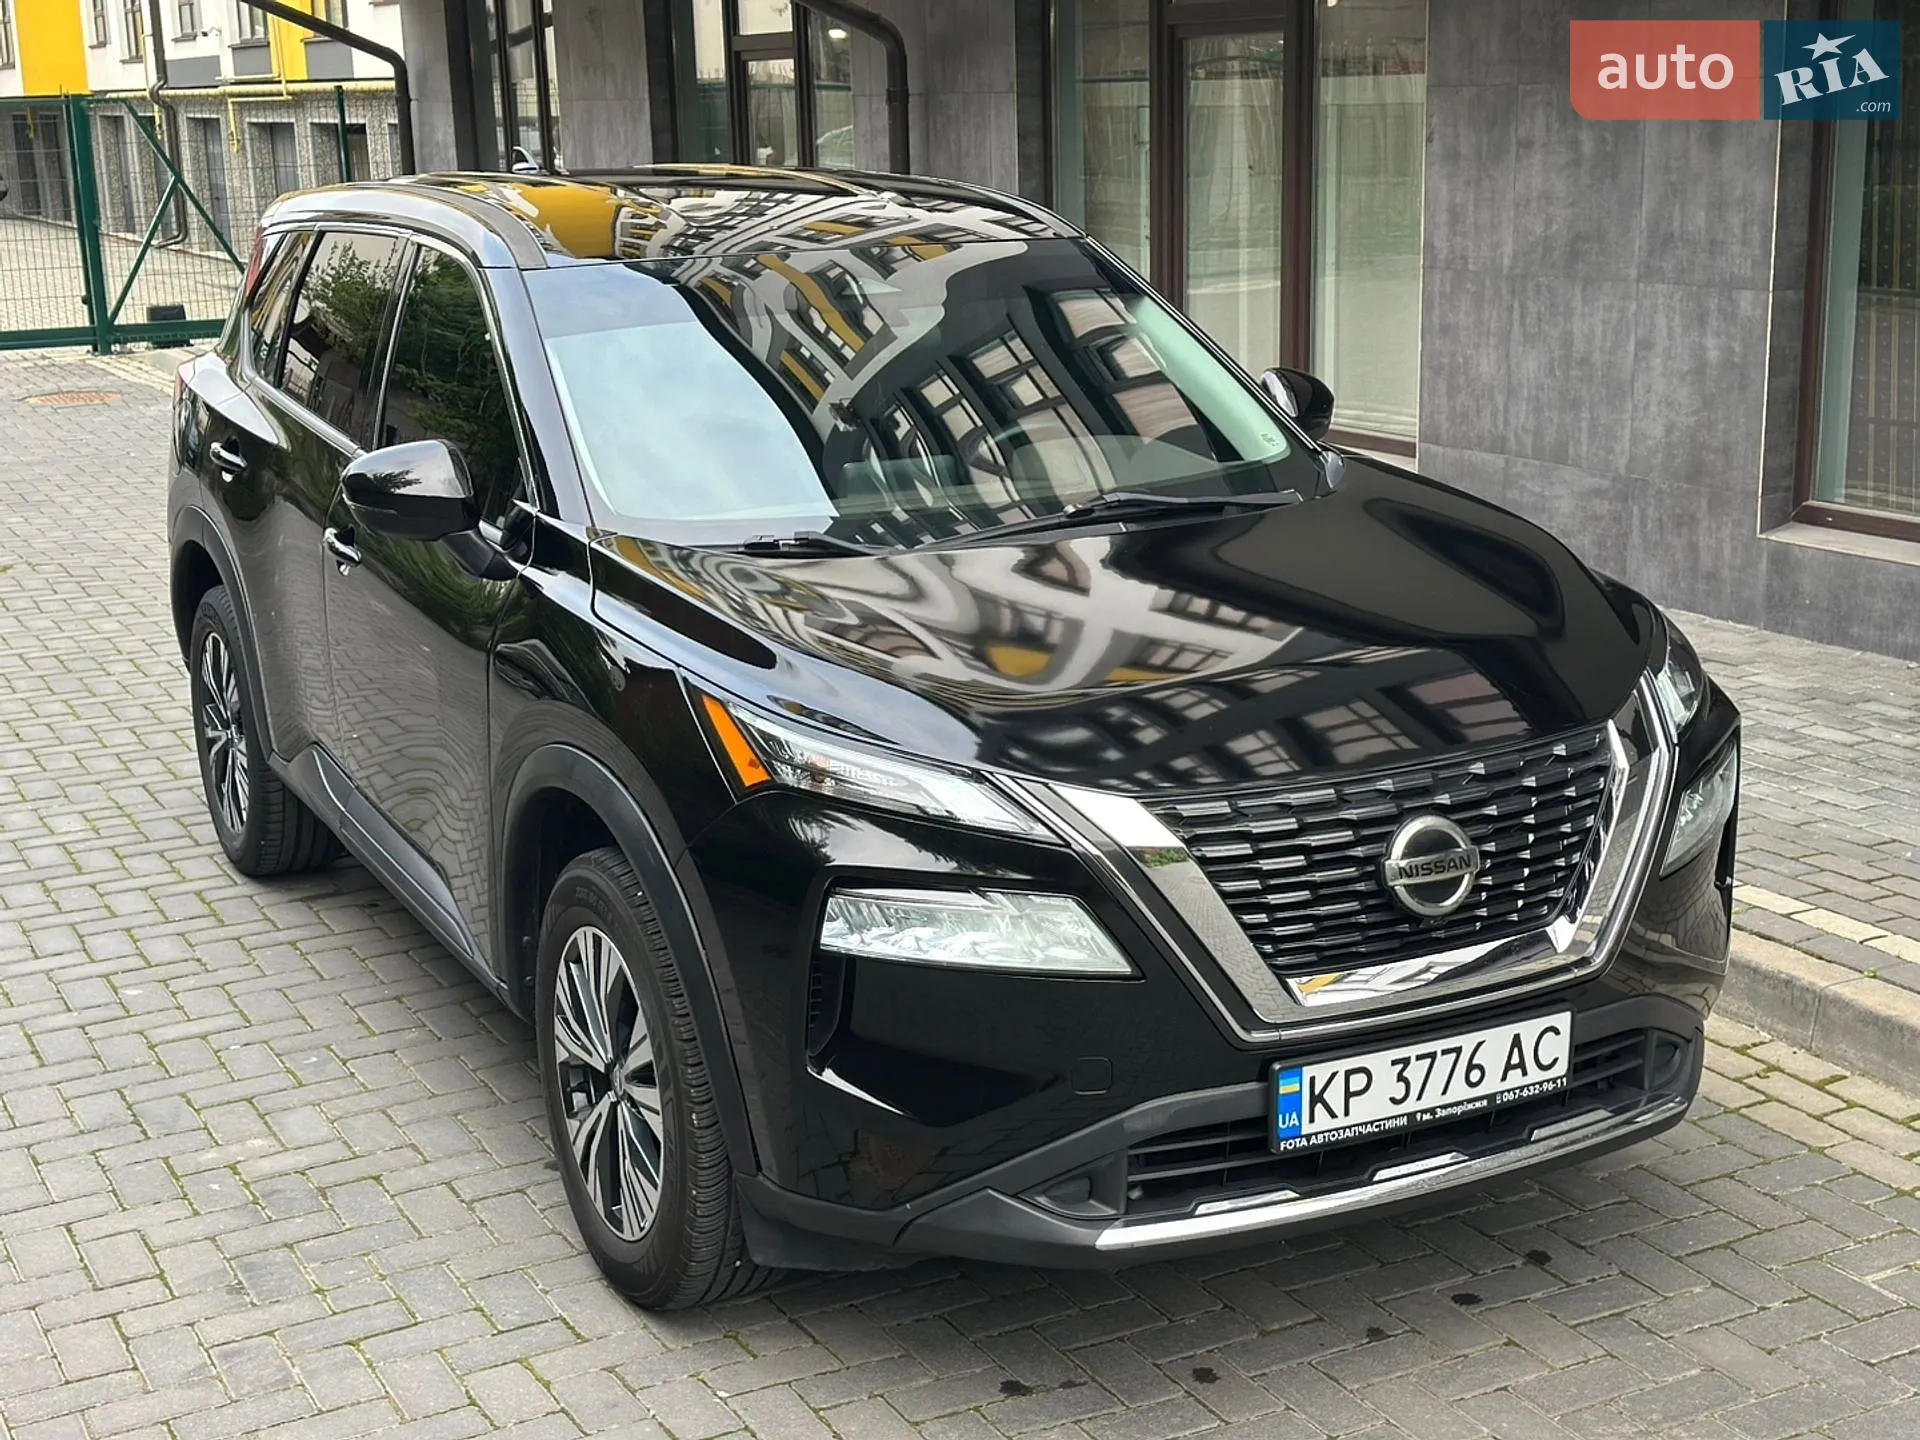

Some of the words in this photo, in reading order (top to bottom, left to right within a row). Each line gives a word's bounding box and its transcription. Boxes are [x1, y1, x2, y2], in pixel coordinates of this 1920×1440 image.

[1398, 854, 1471, 880] NISSAN
[1308, 1066, 1373, 1124] KP
[1388, 1039, 1487, 1106] 3776
[1500, 1025, 1562, 1083] AC
[1278, 1112, 1300, 1128] UA
[1309, 1115, 1408, 1145] АВТОЗАПЧАСТИНИ
[1502, 1077, 1567, 1102] 067-632-96-11
